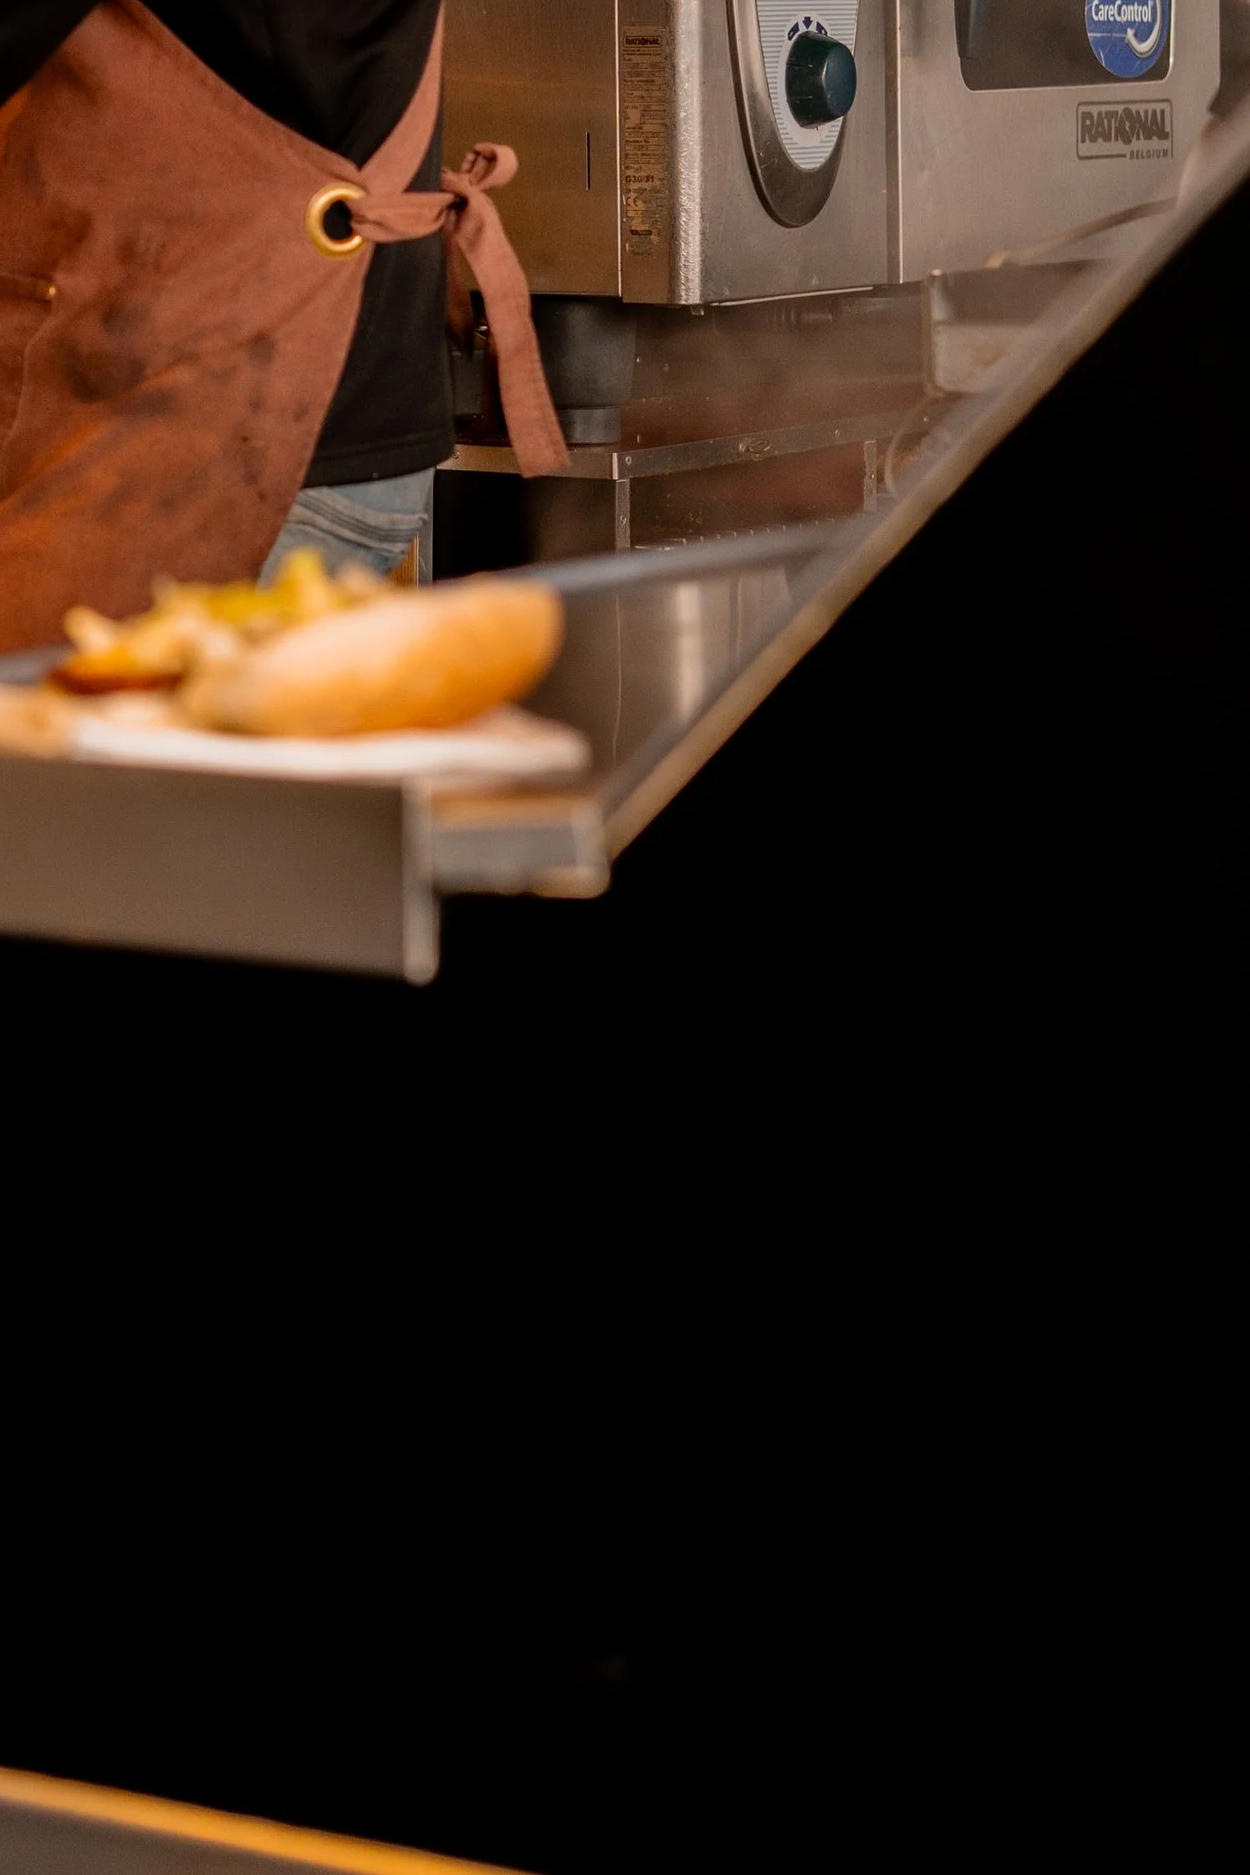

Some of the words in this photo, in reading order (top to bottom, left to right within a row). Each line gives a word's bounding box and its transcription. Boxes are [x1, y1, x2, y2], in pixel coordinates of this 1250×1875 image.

[1091, 0, 1152, 23] CareControl
[1080, 106, 1170, 146] RATIONAL
[1129, 148, 1169, 161] BELGIUM
